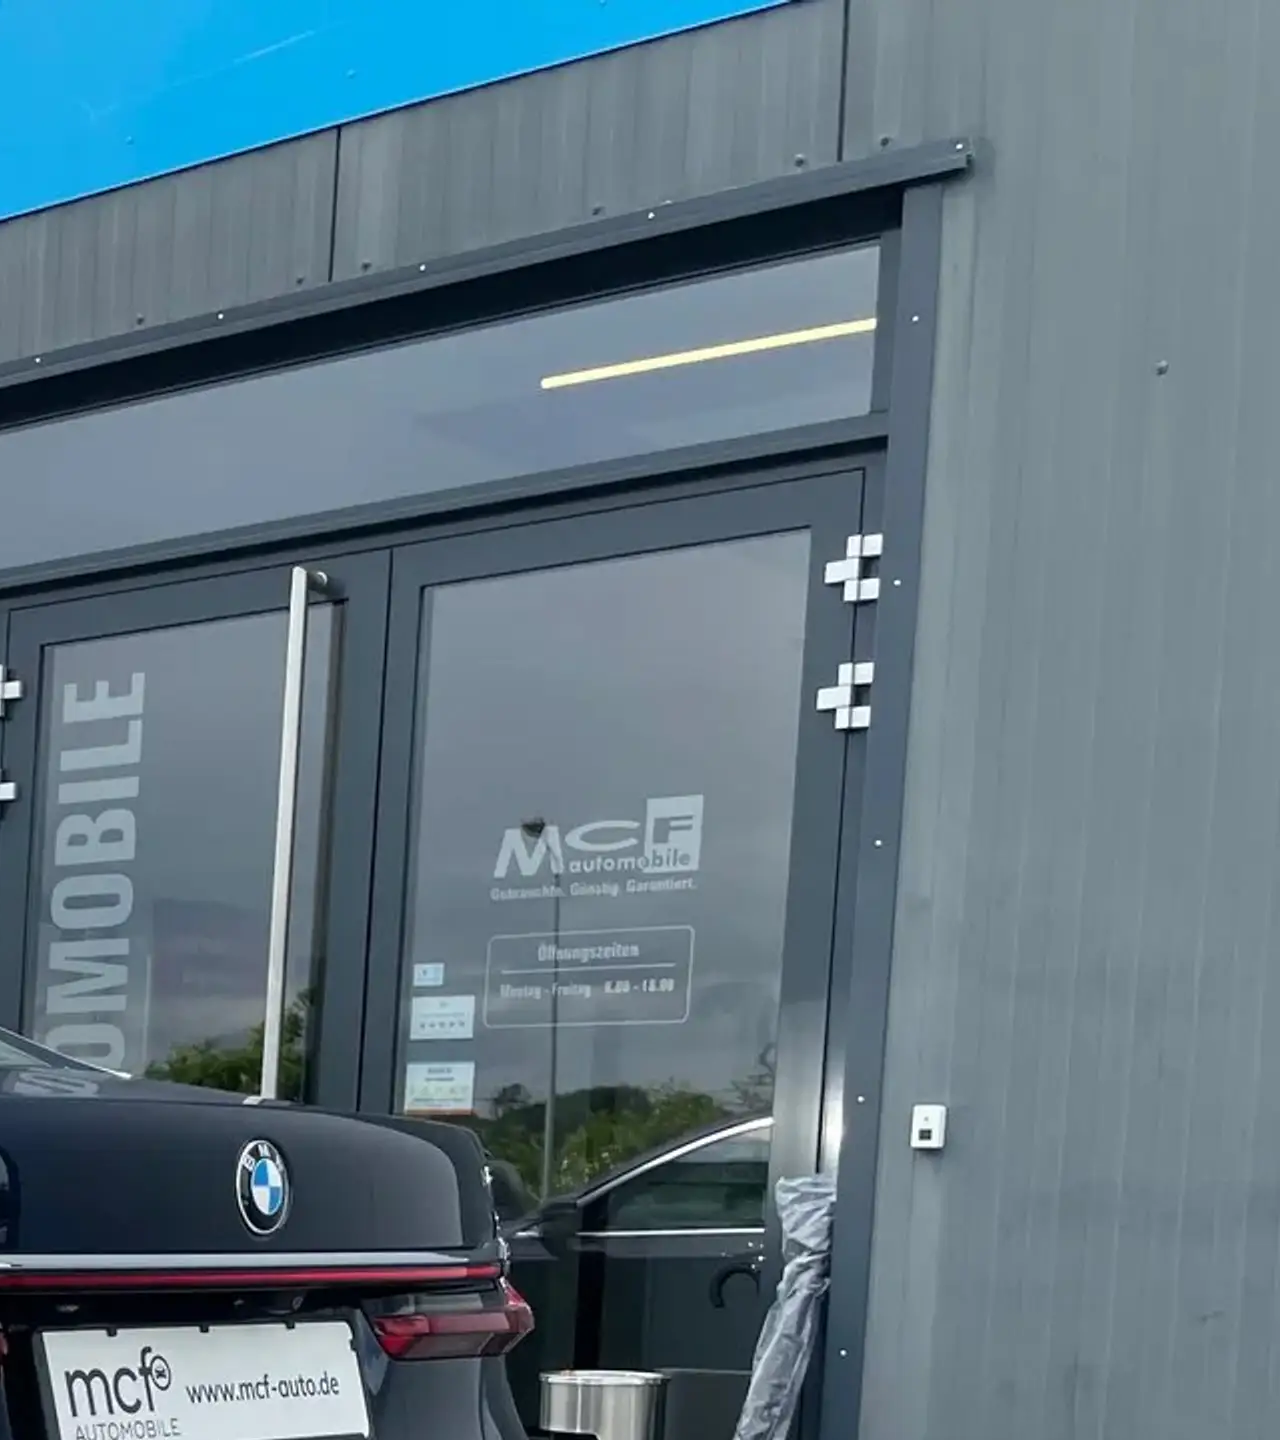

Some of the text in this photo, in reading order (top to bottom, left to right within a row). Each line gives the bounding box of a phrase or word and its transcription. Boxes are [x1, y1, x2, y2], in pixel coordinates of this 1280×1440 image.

[493, 815, 696, 878] MCF
[569, 849, 691, 874] automobile
[64, 1346, 157, 1417] mcf
[185, 1371, 340, 1404] www.mcf-auto.de
